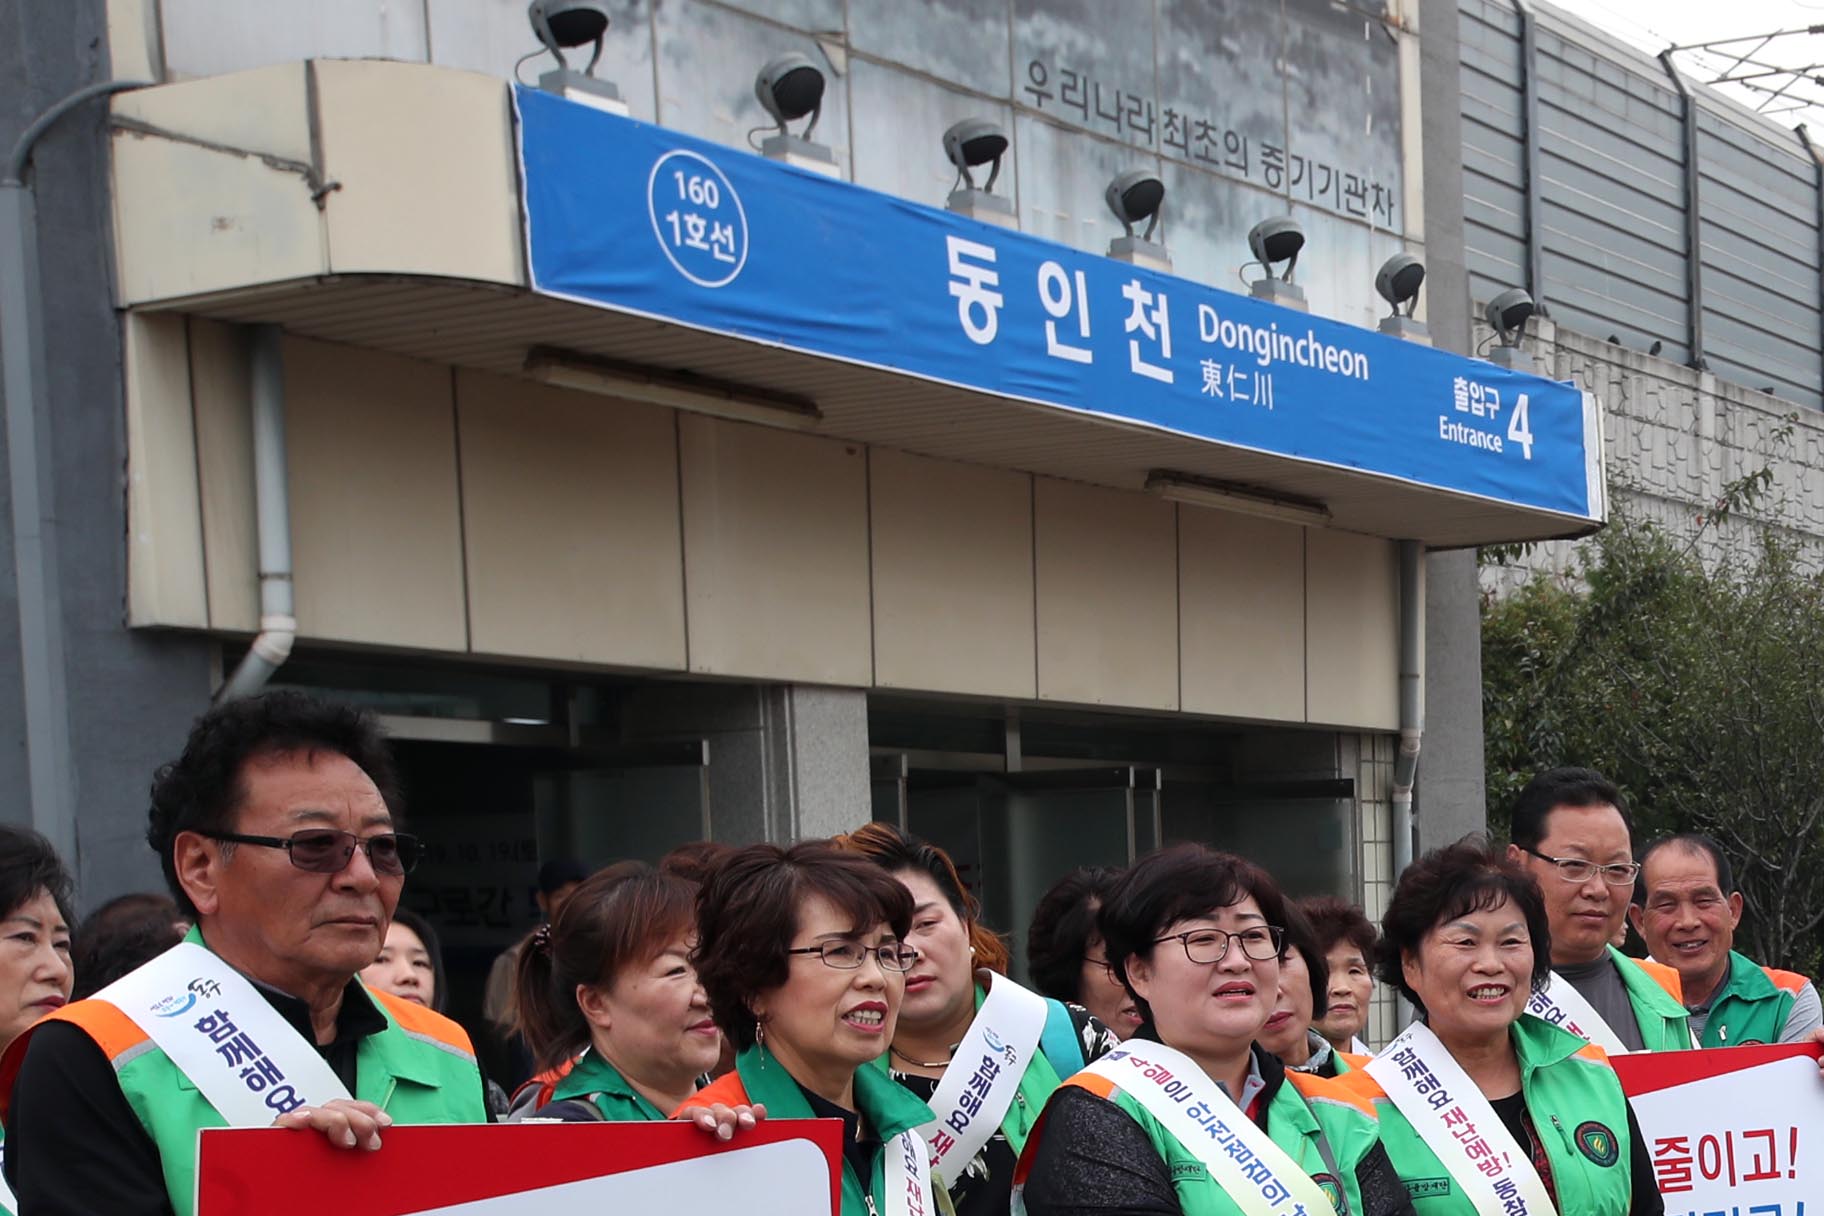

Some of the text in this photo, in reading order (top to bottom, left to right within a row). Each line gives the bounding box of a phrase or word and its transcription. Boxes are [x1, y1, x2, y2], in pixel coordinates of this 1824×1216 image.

[674, 171, 720, 209] 160
[666, 210, 737, 264] 1호선
[945, 234, 1174, 384] 동인천
[1199, 304, 1370, 382] Dongincheon
[1200, 358, 1275, 411] 東仁川
[1452, 375, 1501, 421] 출입구
[1439, 392, 1534, 461] Entrance 4
[193, 1008, 306, 1119] 함께해요
[945, 1054, 1001, 1135] 함께해요
[1130, 1056, 1193, 1103] 4일은
[1186, 1101, 1291, 1208] 안전점검의
[1391, 1047, 1453, 1111] 함께해요
[1440, 1106, 1513, 1178] 재난예방!
[1653, 1126, 1798, 1194] 줄이고!
